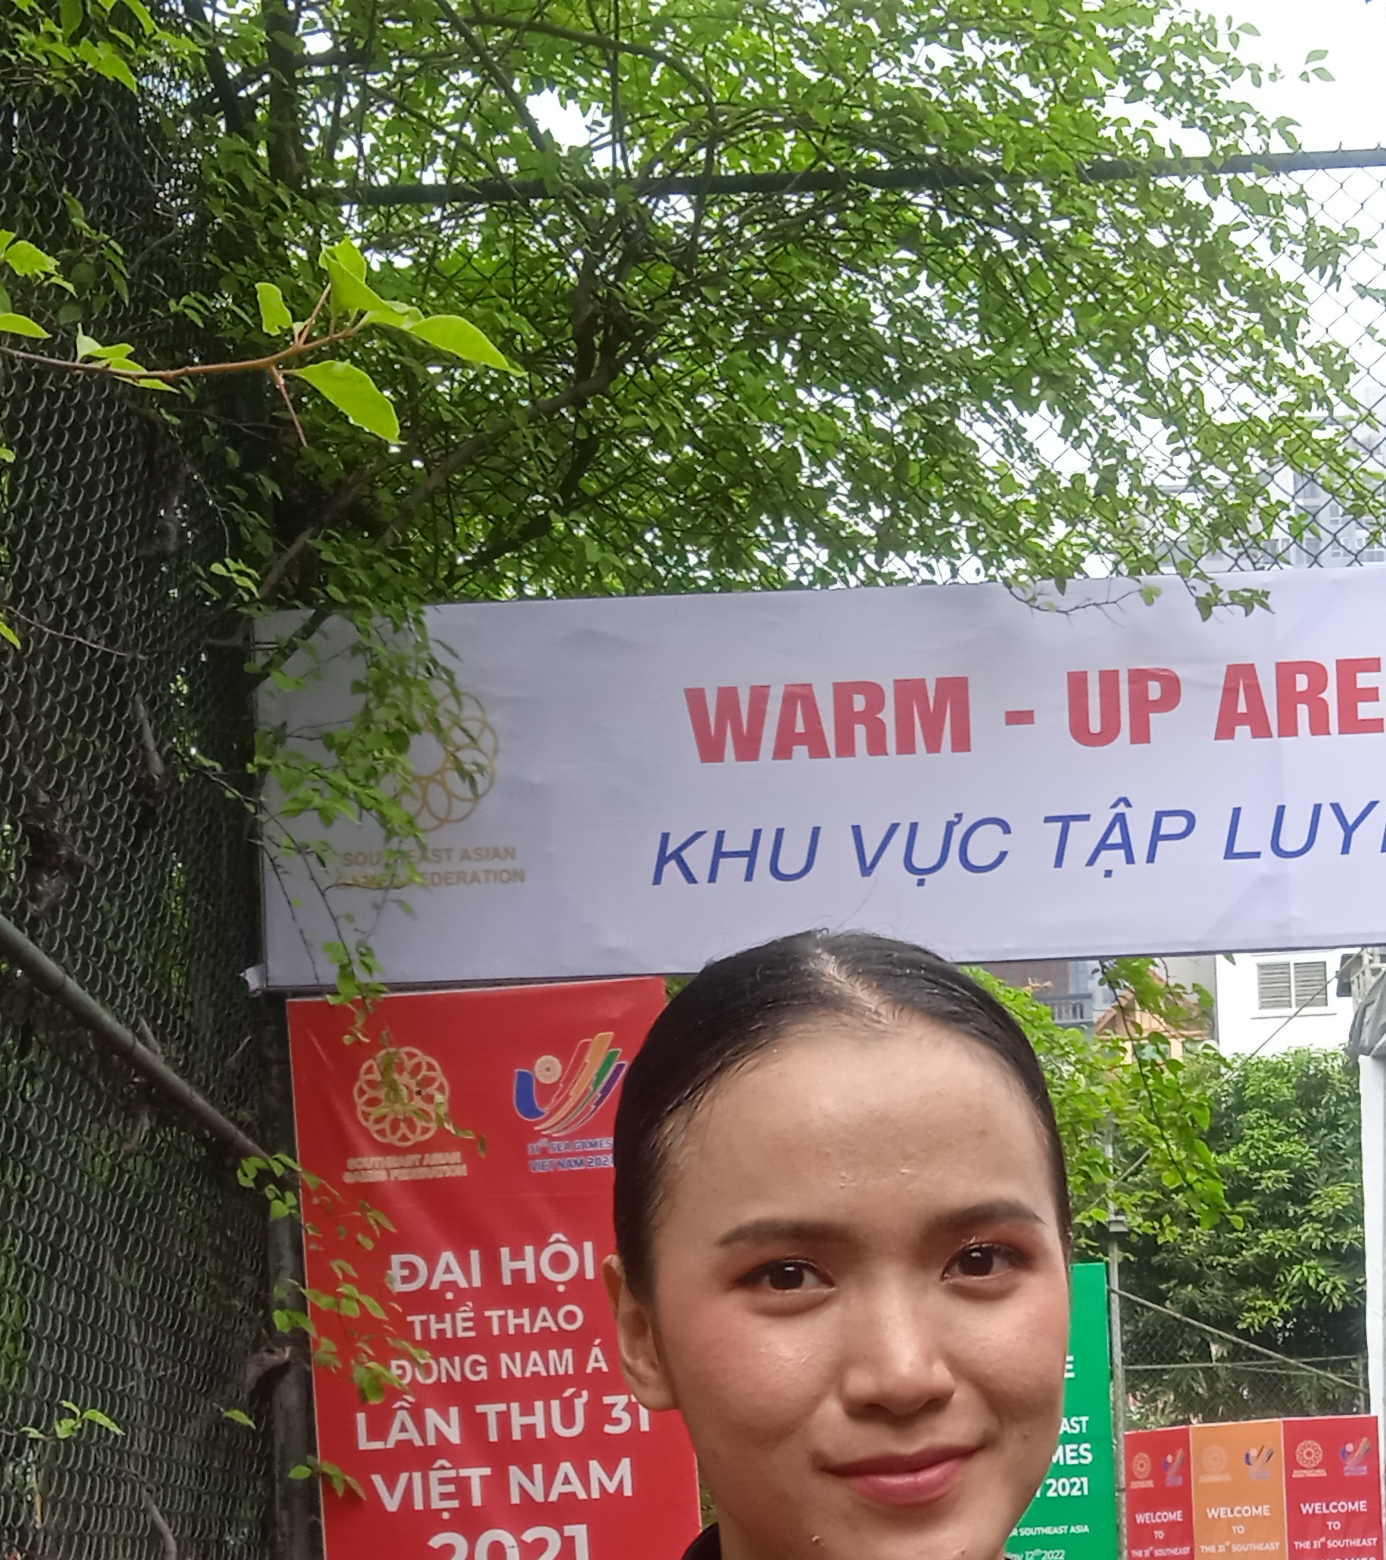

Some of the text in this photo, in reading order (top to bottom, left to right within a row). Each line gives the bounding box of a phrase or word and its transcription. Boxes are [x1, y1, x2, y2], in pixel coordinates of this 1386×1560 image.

[684, 676, 971, 764] WARM
[1067, 667, 1182, 748] UP
[651, 826, 820, 886] KHU
[852, 811, 1012, 887] VỰC
[1043, 797, 1196, 879] TẬP
[459, 846, 516, 862] ASIAN
[557, 1157, 586, 1170] NAM
[389, 1233, 596, 1300] ĐẠI HỘI
[407, 1302, 584, 1341] THỂ THAO
[500, 1348, 574, 1380] NAM
[585, 1339, 609, 1373] Á
[356, 1388, 651, 1450] LẦN THỨ 31
[371, 1457, 634, 1519] VIỆT NAM
[1046, 1477, 1089, 1498] 2021
[1206, 1505, 1271, 1519] WELCOME
[1300, 1500, 1367, 1514] WELCOME
[1135, 1510, 1183, 1524] WELCOME
[1231, 1525, 1245, 1534] TO
[1326, 1521, 1341, 1530] TO
[1154, 1530, 1164, 1539] TO
[1326, 1537, 1377, 1548] SOUTHEAST
